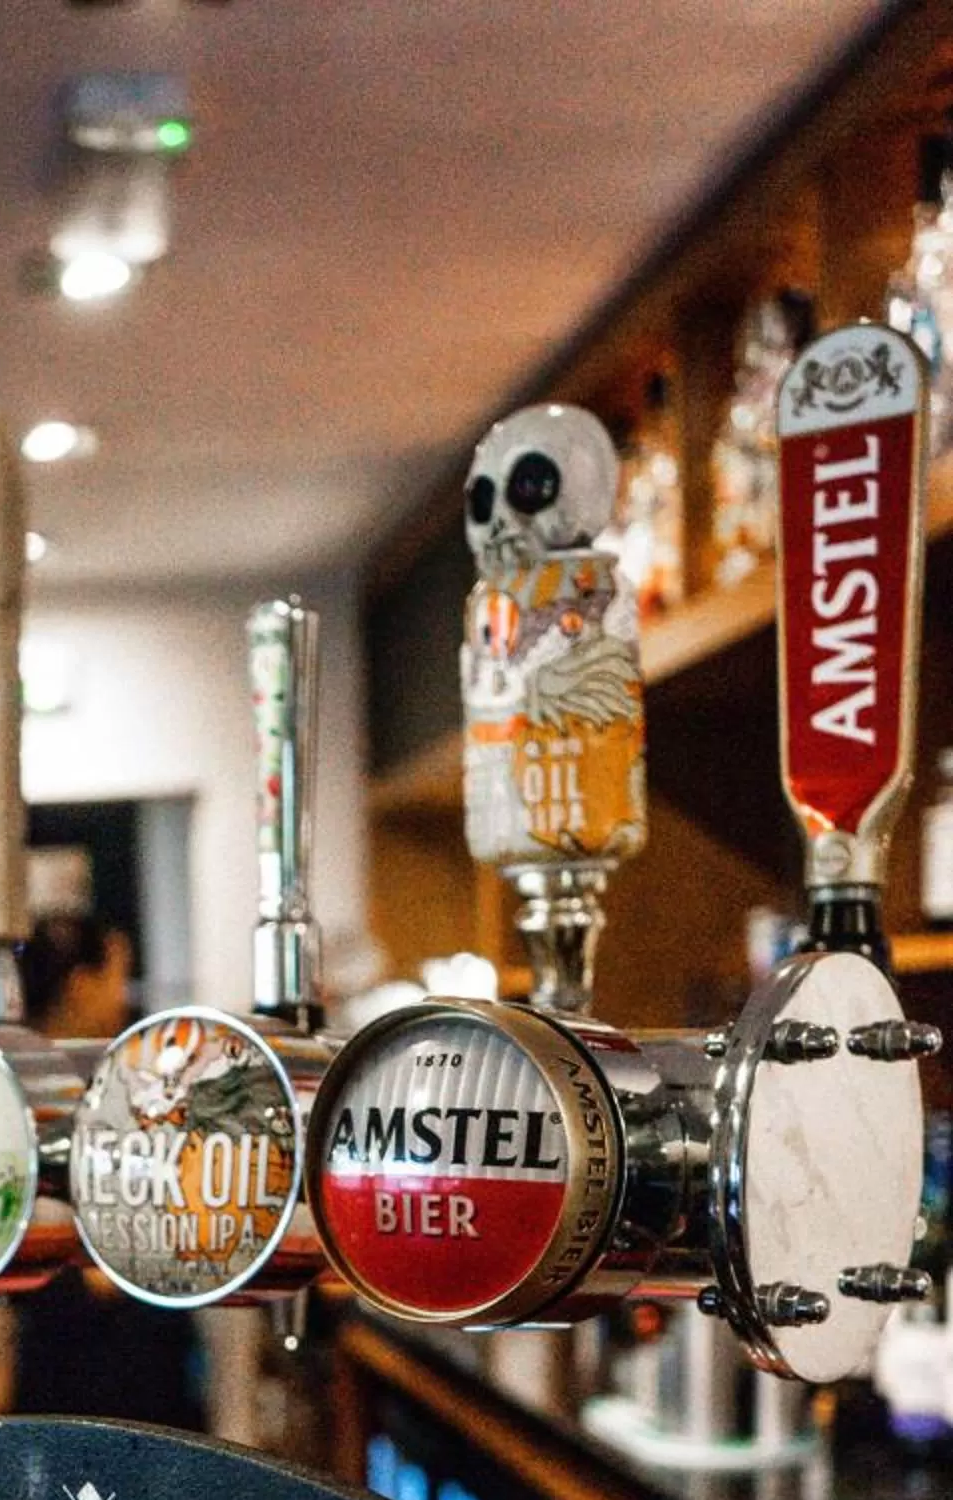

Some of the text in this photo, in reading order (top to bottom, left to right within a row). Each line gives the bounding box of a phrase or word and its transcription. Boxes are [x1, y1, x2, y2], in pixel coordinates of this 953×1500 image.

[810, 433, 881, 746] AMSTEL
[415, 1053, 463, 1067] 1870
[327, 1107, 560, 1170] AMSTEL
[558, 1056, 609, 1193] AMSTEL
[201, 1131, 285, 1208] OIL
[210, 1214, 256, 1251] IPA
[375, 1192, 481, 1238] BIER
